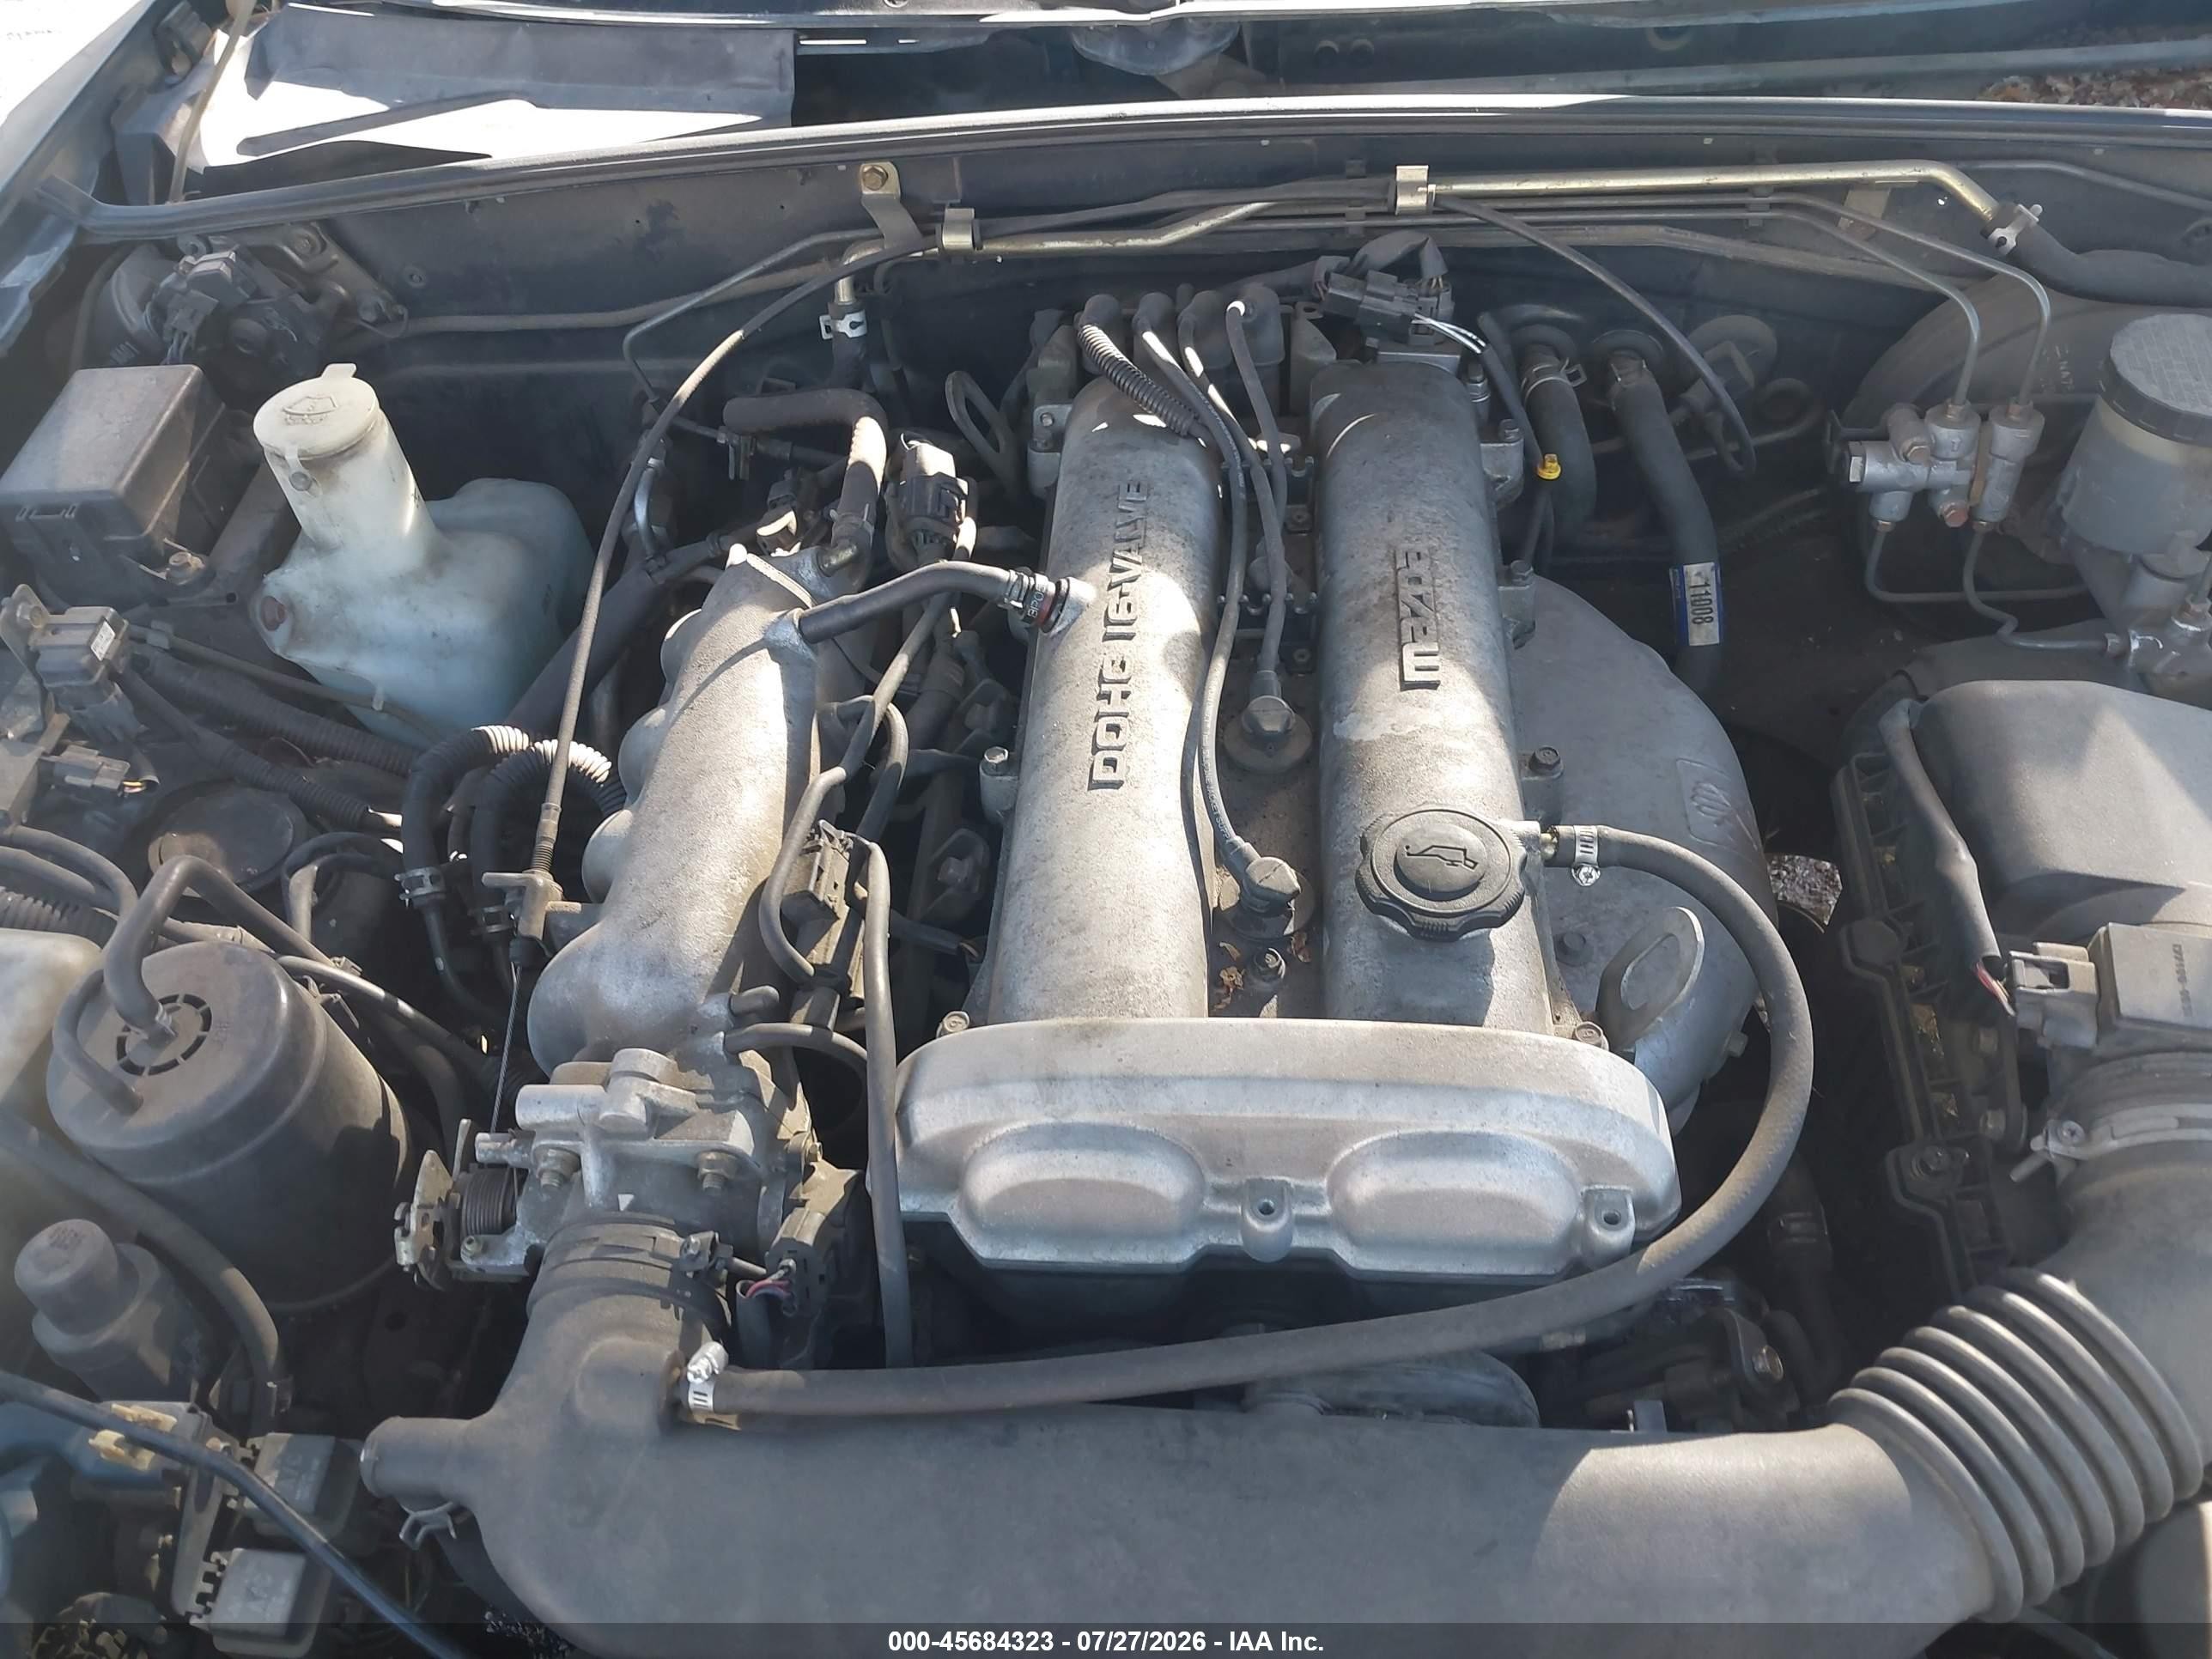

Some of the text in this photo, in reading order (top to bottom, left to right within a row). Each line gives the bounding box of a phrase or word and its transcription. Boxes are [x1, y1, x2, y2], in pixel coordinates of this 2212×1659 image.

[1087, 481, 1148, 791] DOHC 16-VALVE
[1688, 580, 1715, 624] 11008
